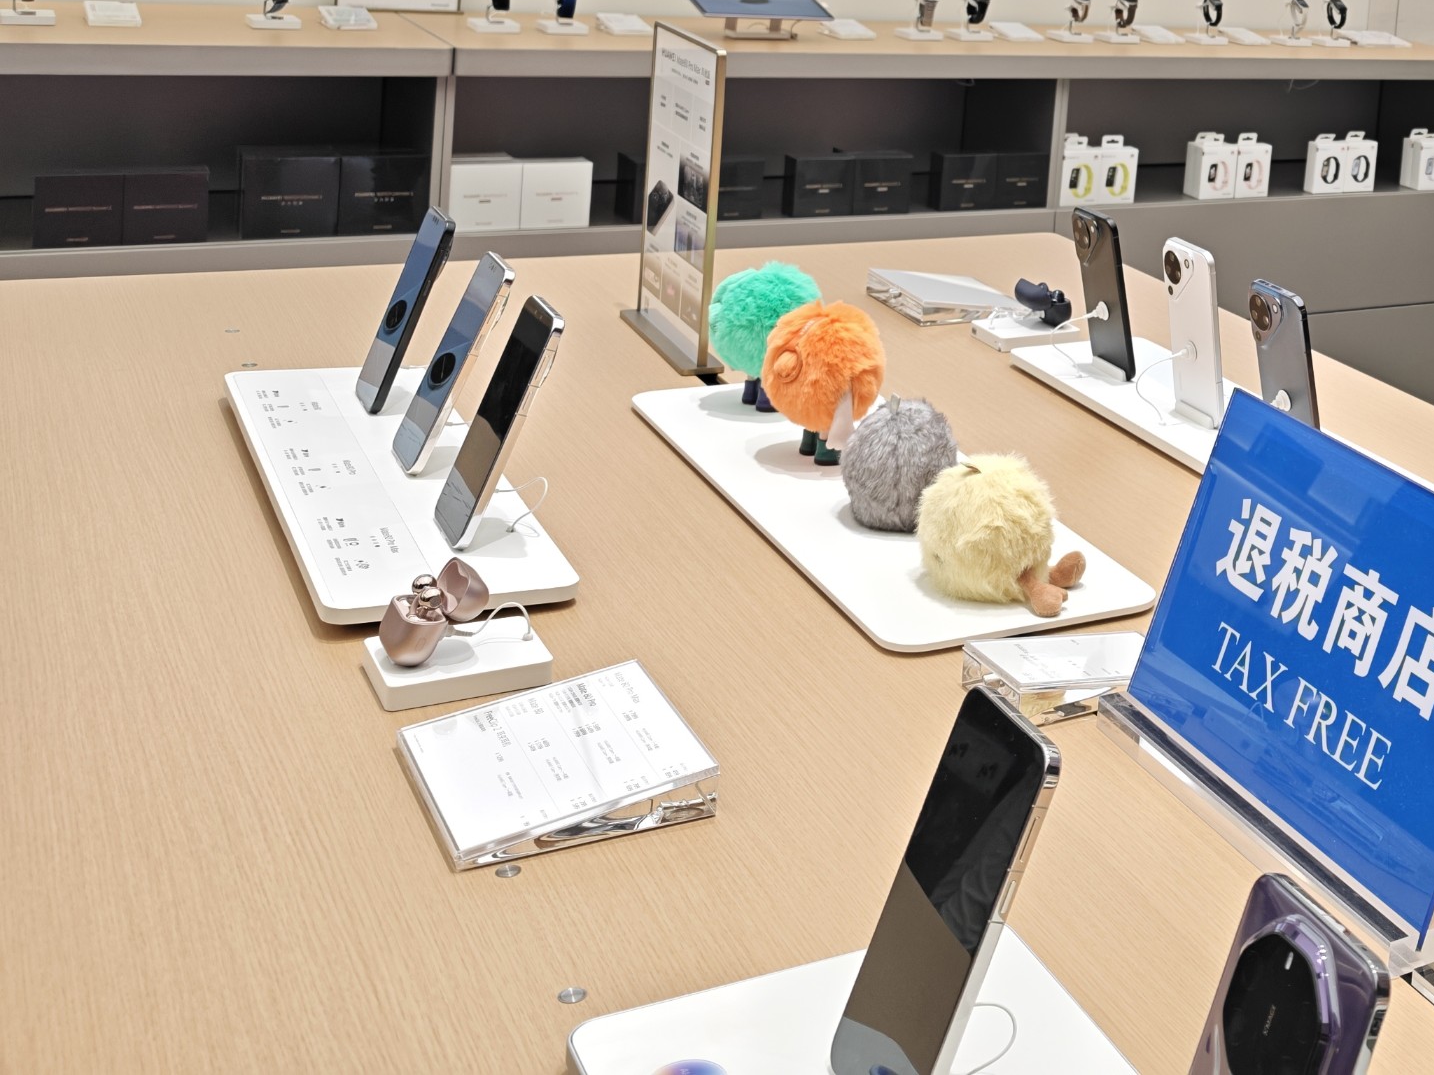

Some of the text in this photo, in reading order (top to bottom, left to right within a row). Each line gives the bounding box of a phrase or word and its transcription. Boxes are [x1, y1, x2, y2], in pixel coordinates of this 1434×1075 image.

[574, 682, 590, 694] Mate
[1211, 621, 1392, 790] TAX FREE
[481, 710, 500, 728] FreeClip
